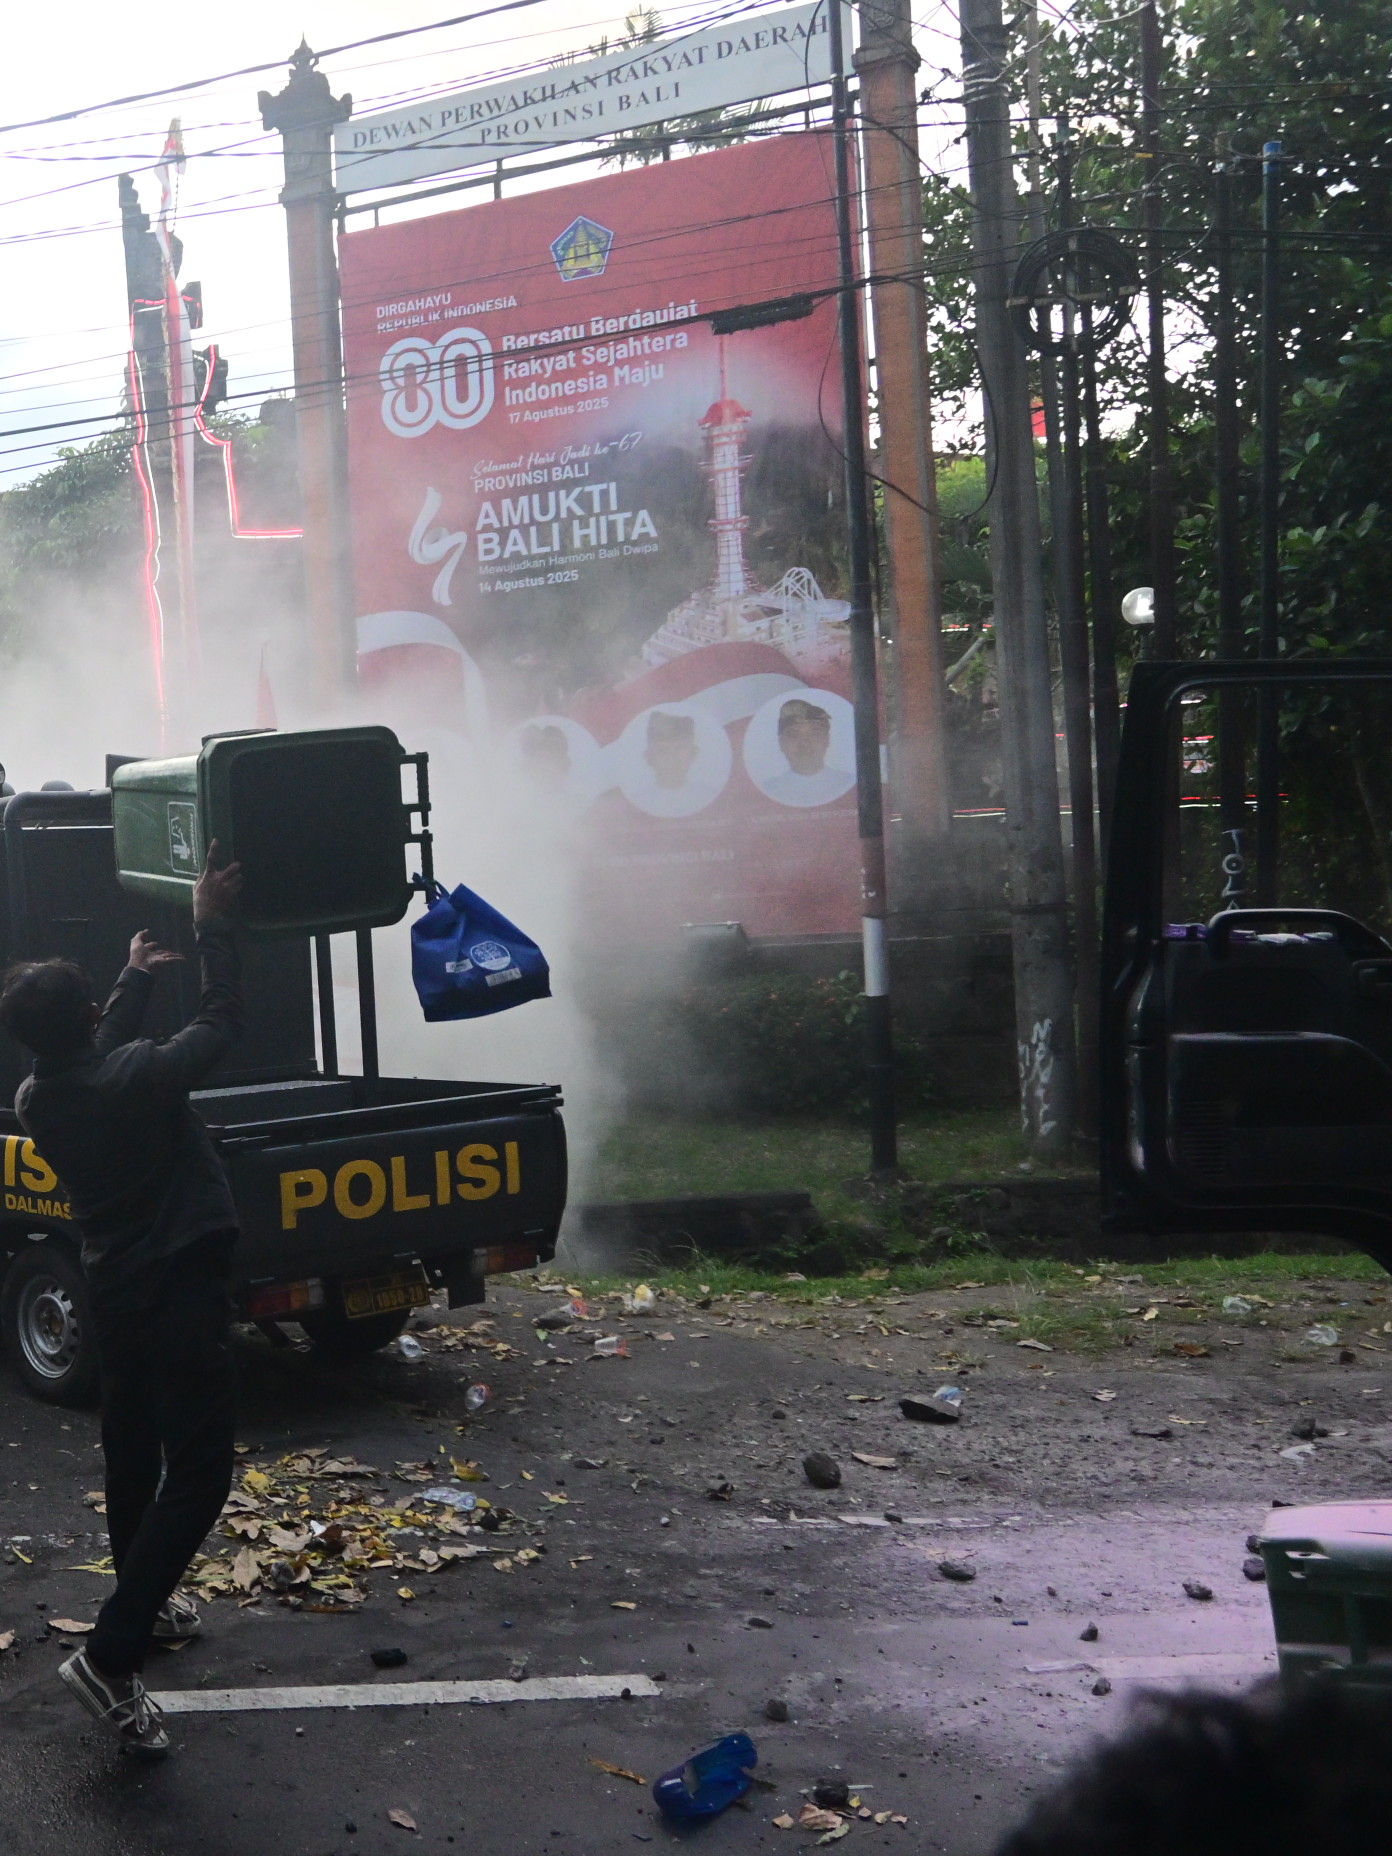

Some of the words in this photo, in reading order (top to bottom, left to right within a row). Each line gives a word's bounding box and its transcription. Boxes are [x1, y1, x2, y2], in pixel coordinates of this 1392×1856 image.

[353, 113, 433, 149] DEWAN
[440, 74, 598, 128] PERWAKILAN
[608, 45, 709, 87] RAKYAT
[716, 15, 829, 60] DAERAH
[480, 100, 603, 144] PROVINSI
[618, 82, 681, 112] BALI
[376, 292, 452, 318] DIRGAHAYU
[377, 310, 441, 334] REPUBLIK
[444, 295, 518, 319] INDONESIA
[502, 323, 585, 352] Bersatu
[590, 300, 699, 336] Berdaulat
[503, 350, 576, 380] Rakyat
[581, 332, 689, 367] Sejahtera
[379, 326, 495, 438] 80
[505, 371, 608, 406] Indonesia
[614, 360, 665, 387] Maju
[508, 411, 521, 424] 17
[523, 404, 575, 424] Agustus
[577, 396, 609, 412] 2025
[470, 454, 525, 480] Selamat
[527, 452, 557, 470] Hari
[560, 445, 591, 466] Jadi
[474, 469, 548, 493] PROVINSI
[551, 462, 590, 482] BALI
[475, 482, 618, 531] AMUKTI
[477, 522, 560, 562] BALI
[572, 509, 658, 549] HITA
[479, 557, 546, 576] Mewujudkan
[549, 552, 596, 568] Harmoni
[598, 548, 620, 560] Bali
[623, 542, 659, 557] Dwipa
[479, 581, 492, 593] 14
[494, 575, 545, 593] Agustus
[547, 569, 579, 584] 2025
[5, 1193, 73, 1220] DALMAS
[280, 1141, 520, 1230] POLISI
